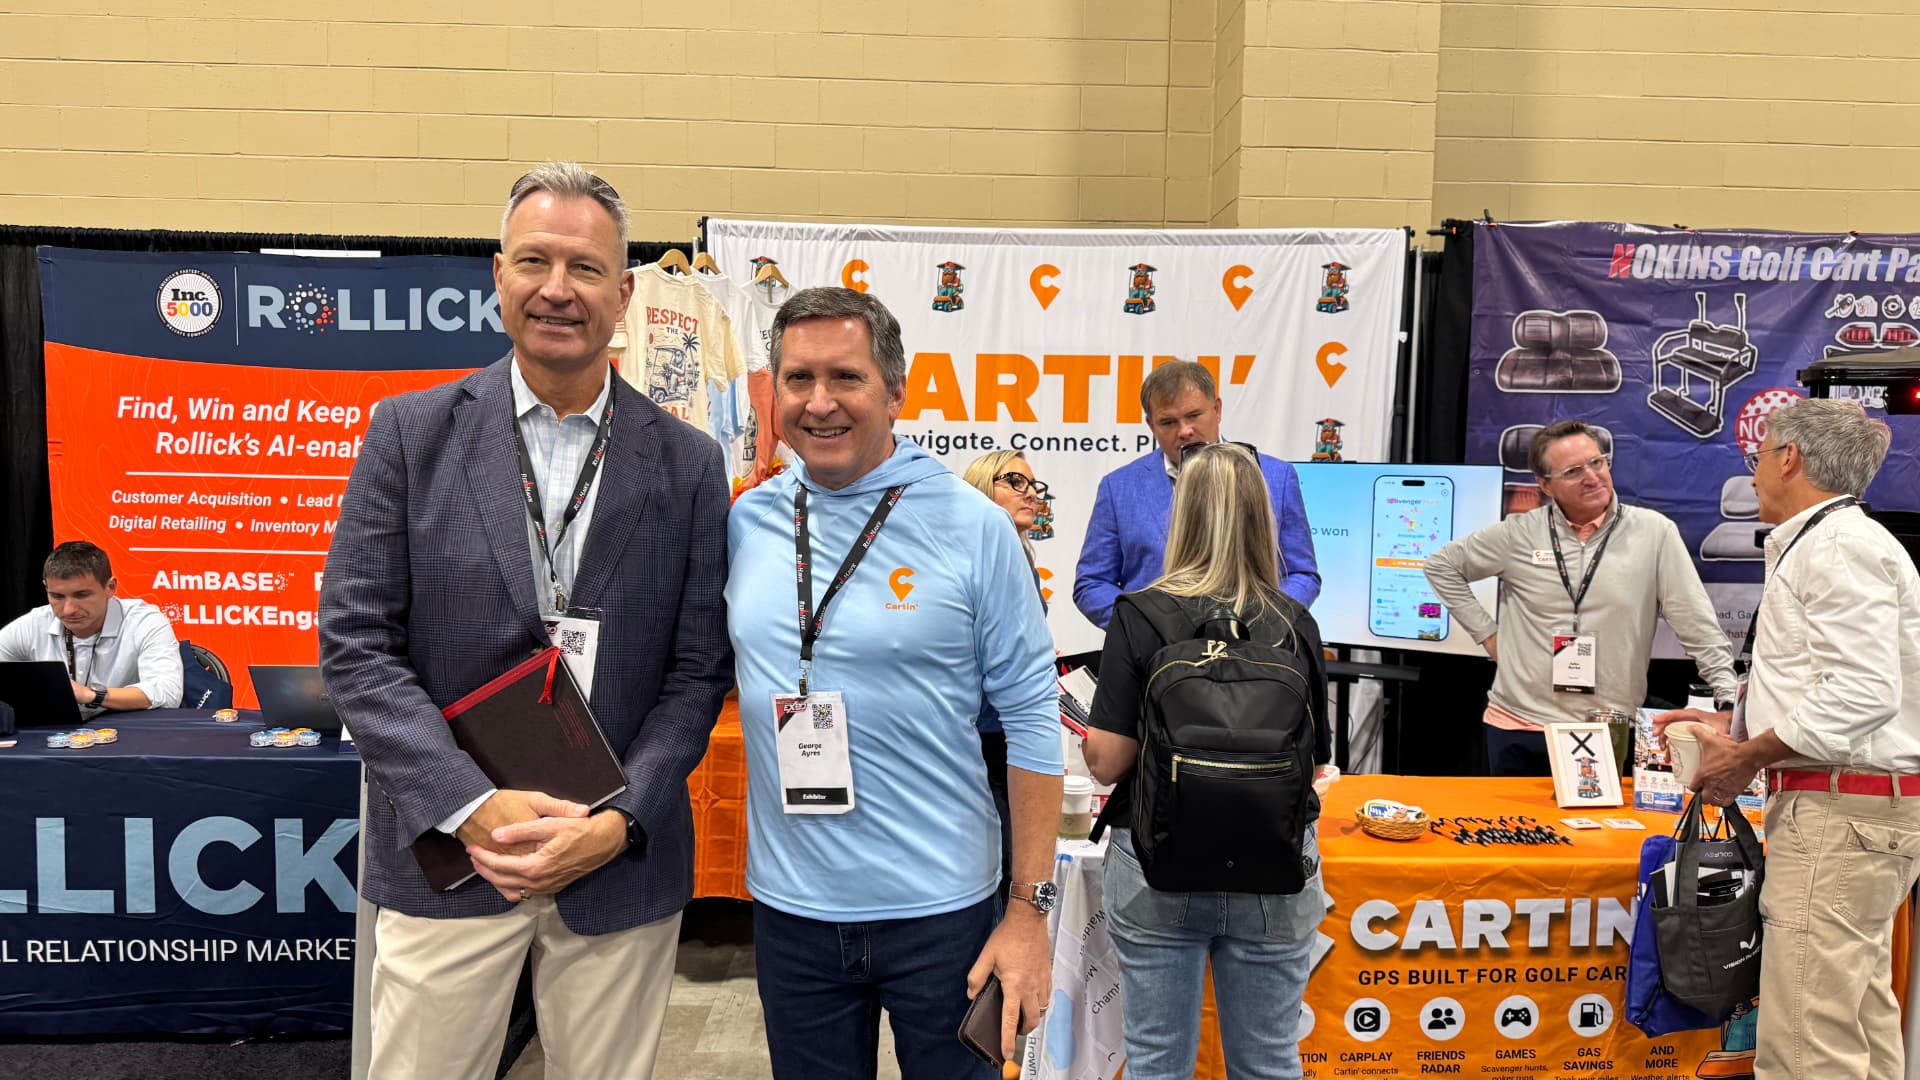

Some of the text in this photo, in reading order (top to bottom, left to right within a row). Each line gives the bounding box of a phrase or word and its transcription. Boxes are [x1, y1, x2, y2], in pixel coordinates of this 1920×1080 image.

[1608, 243, 1732, 281] NOKINS
[1738, 245, 1808, 281] Golf
[1810, 246, 1883, 281] Cart
[171, 288, 209, 302] Inc.
[166, 301, 213, 317] 5000
[646, 306, 699, 335] RESPECT
[666, 326, 679, 335] THE
[117, 395, 178, 425] Find,
[188, 397, 234, 421] Win
[242, 398, 290, 423] and
[296, 400, 361, 430] Keep
[155, 431, 260, 457] Rollick's
[901, 429, 1000, 456] vigate.
[1010, 431, 1127, 453] Connect.
[111, 489, 184, 506] Customer
[187, 491, 272, 508] Acquisition
[297, 493, 334, 508] Lead
[109, 515, 157, 532] Digital
[161, 516, 227, 534] Retailing
[250, 518, 320, 537] Inventory
[1321, 527, 1349, 537] won
[152, 570, 275, 592] AimBASE
[885, 602, 919, 611] Cartin'
[798, 742, 822, 752] George
[801, 750, 821, 758] Ayres
[0, 815, 361, 916] LICK
[26, 938, 238, 964] RELATIONSHIP
[247, 938, 357, 963] MARKE
[1358, 969, 1401, 986] GPS
[1408, 967, 1470, 985] BUILT
[1476, 967, 1517, 984] FOR
[1525, 966, 1579, 983] GOLF
[1028, 1036, 1037, 1076] Brown
[1416, 1050, 1466, 1061] FRIENDS
[1495, 1048, 1537, 1060] GAMES
[1577, 1047, 1601, 1057] GAS
[1650, 1045, 1675, 1055] AND
[1340, 1051, 1393, 1063] CARPLAY
[1421, 1063, 1461, 1074] RADAR
[1481, 1063, 1549, 1074] Scavenger hunts,
[1563, 1060, 1614, 1071] SAVINGS
[1645, 1058, 1679, 1069] MORE
[1333, 1066, 1399, 1076] Cartin' connects
